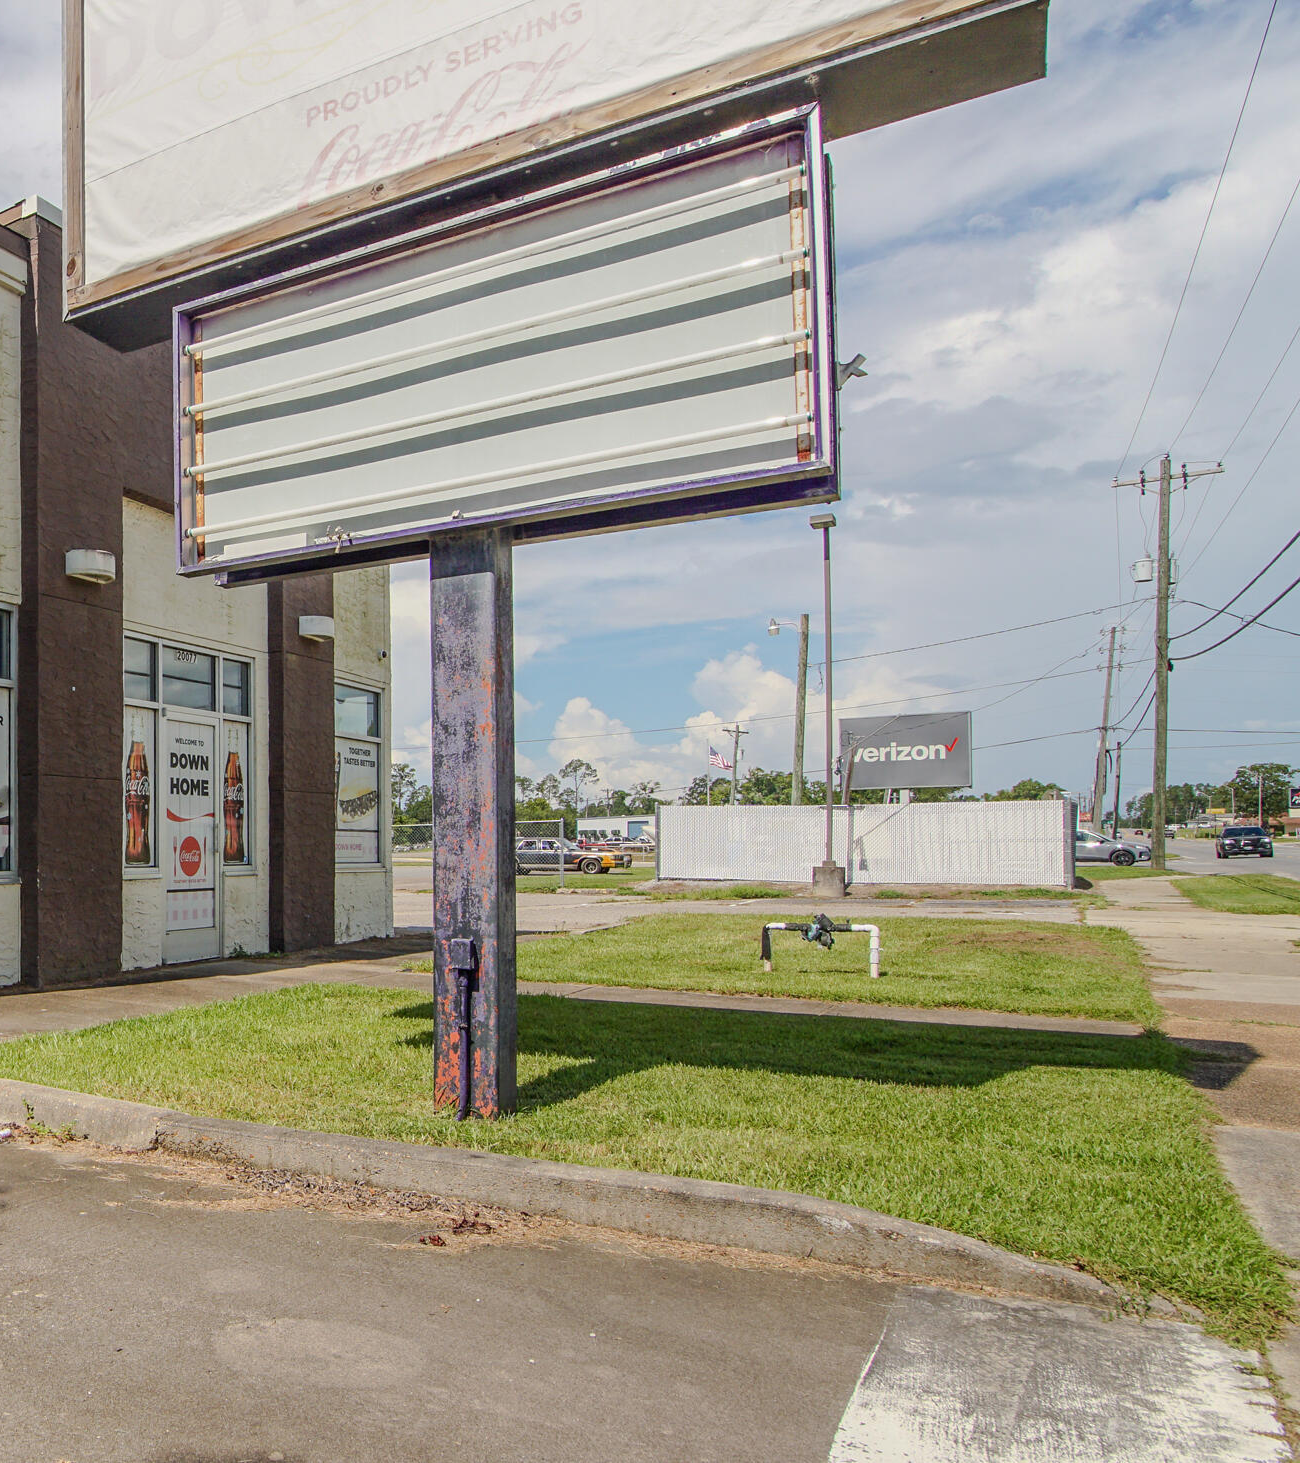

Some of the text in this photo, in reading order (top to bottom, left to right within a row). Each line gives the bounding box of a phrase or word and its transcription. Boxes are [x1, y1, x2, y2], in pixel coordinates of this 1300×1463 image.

[305, 2, 583, 128] PROUDLY SERVING
[175, 737, 197, 746] WELCOME
[170, 752, 209, 771] DOWN
[170, 777, 209, 796] HOME
